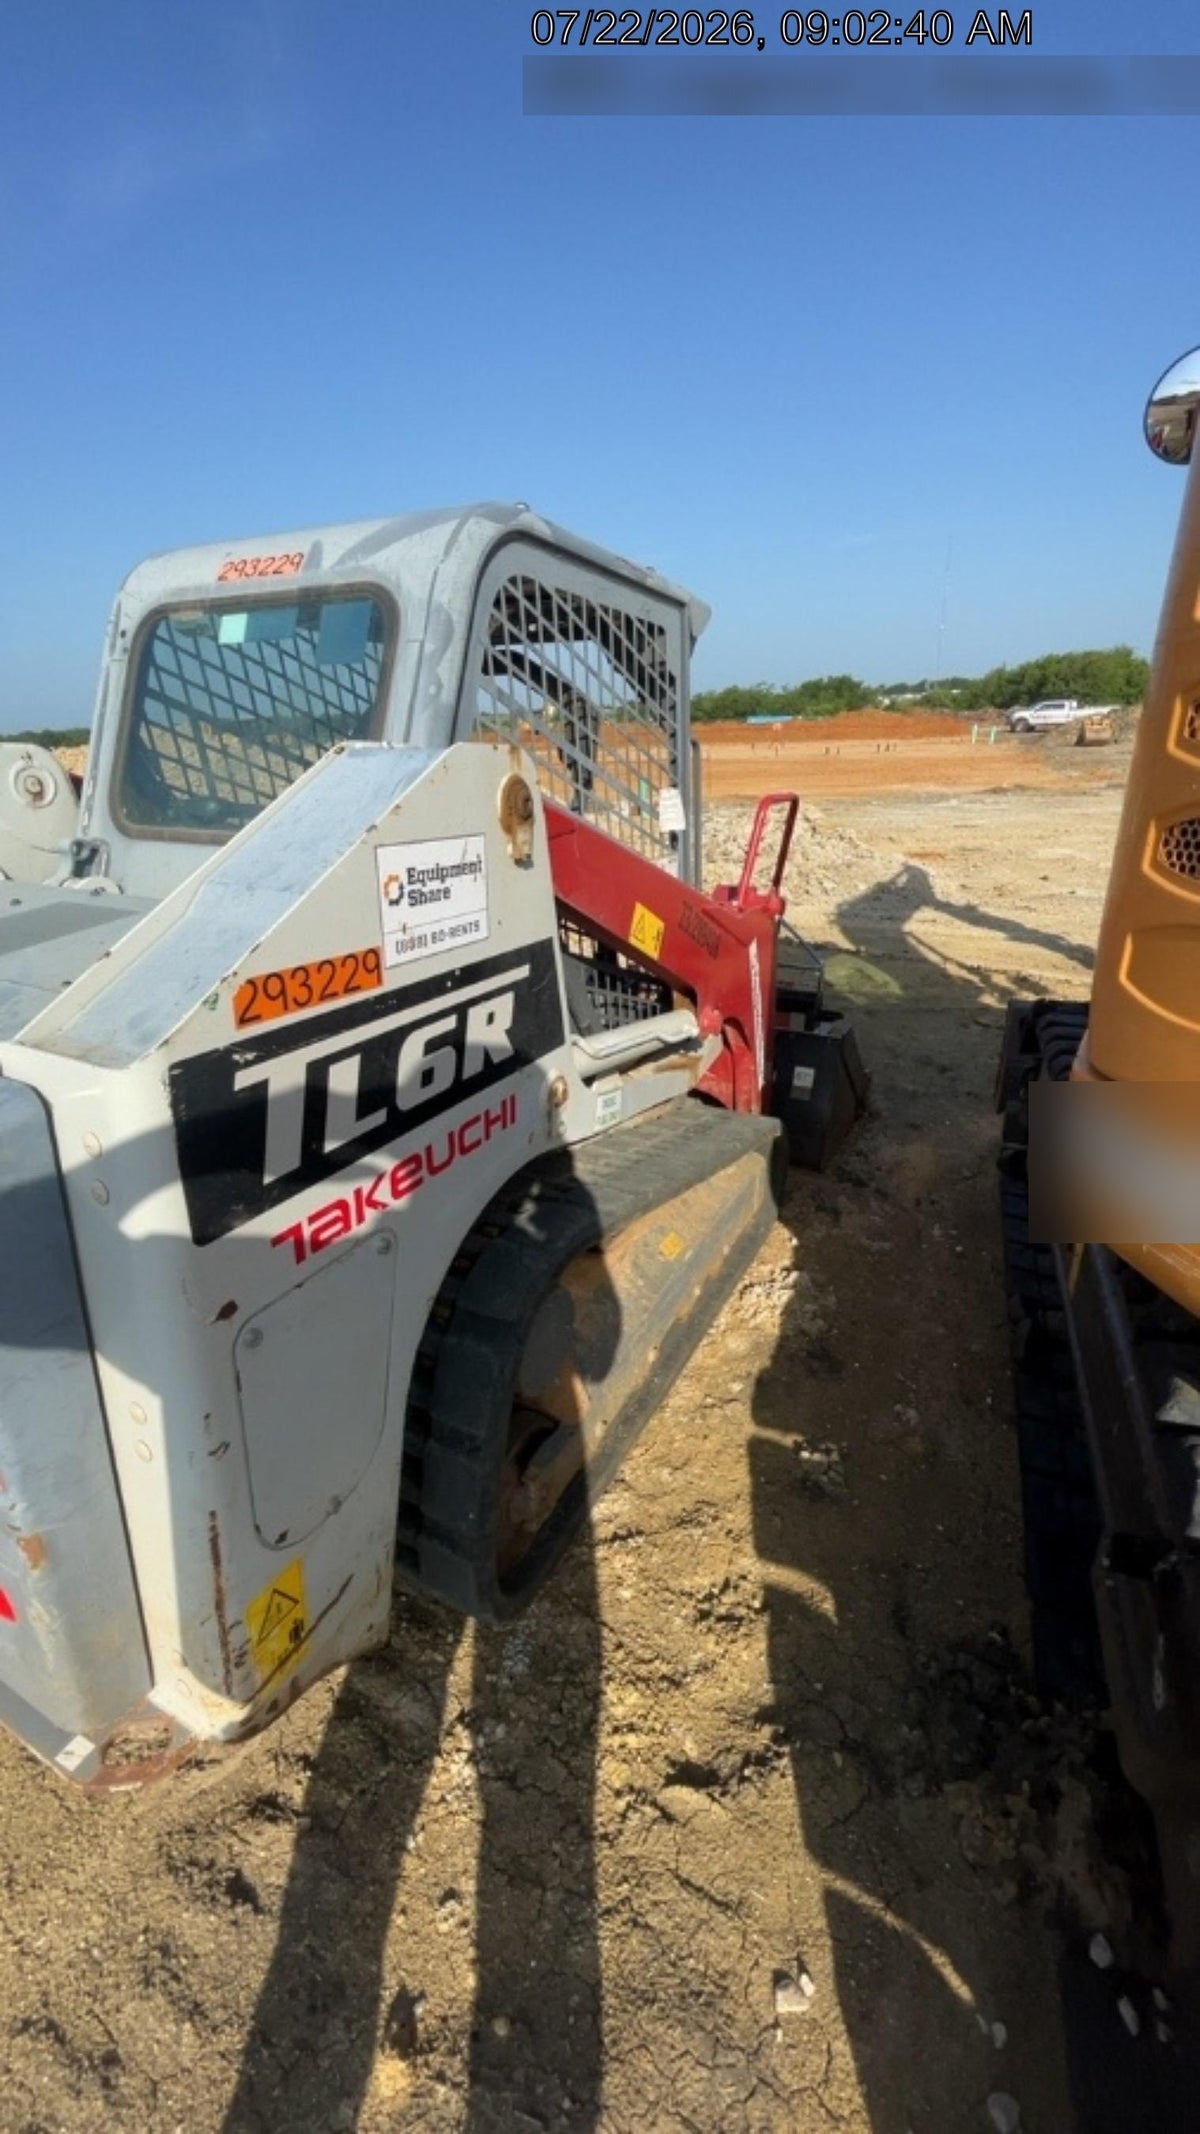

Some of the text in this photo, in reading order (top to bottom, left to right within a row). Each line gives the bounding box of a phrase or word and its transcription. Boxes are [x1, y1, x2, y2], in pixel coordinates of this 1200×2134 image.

[217, 552, 304, 581] 293229
[406, 860, 482, 887] Equipment
[407, 886, 451, 908] Share
[238, 948, 383, 1025] 293229
[234, 963, 531, 1187] TL6R
